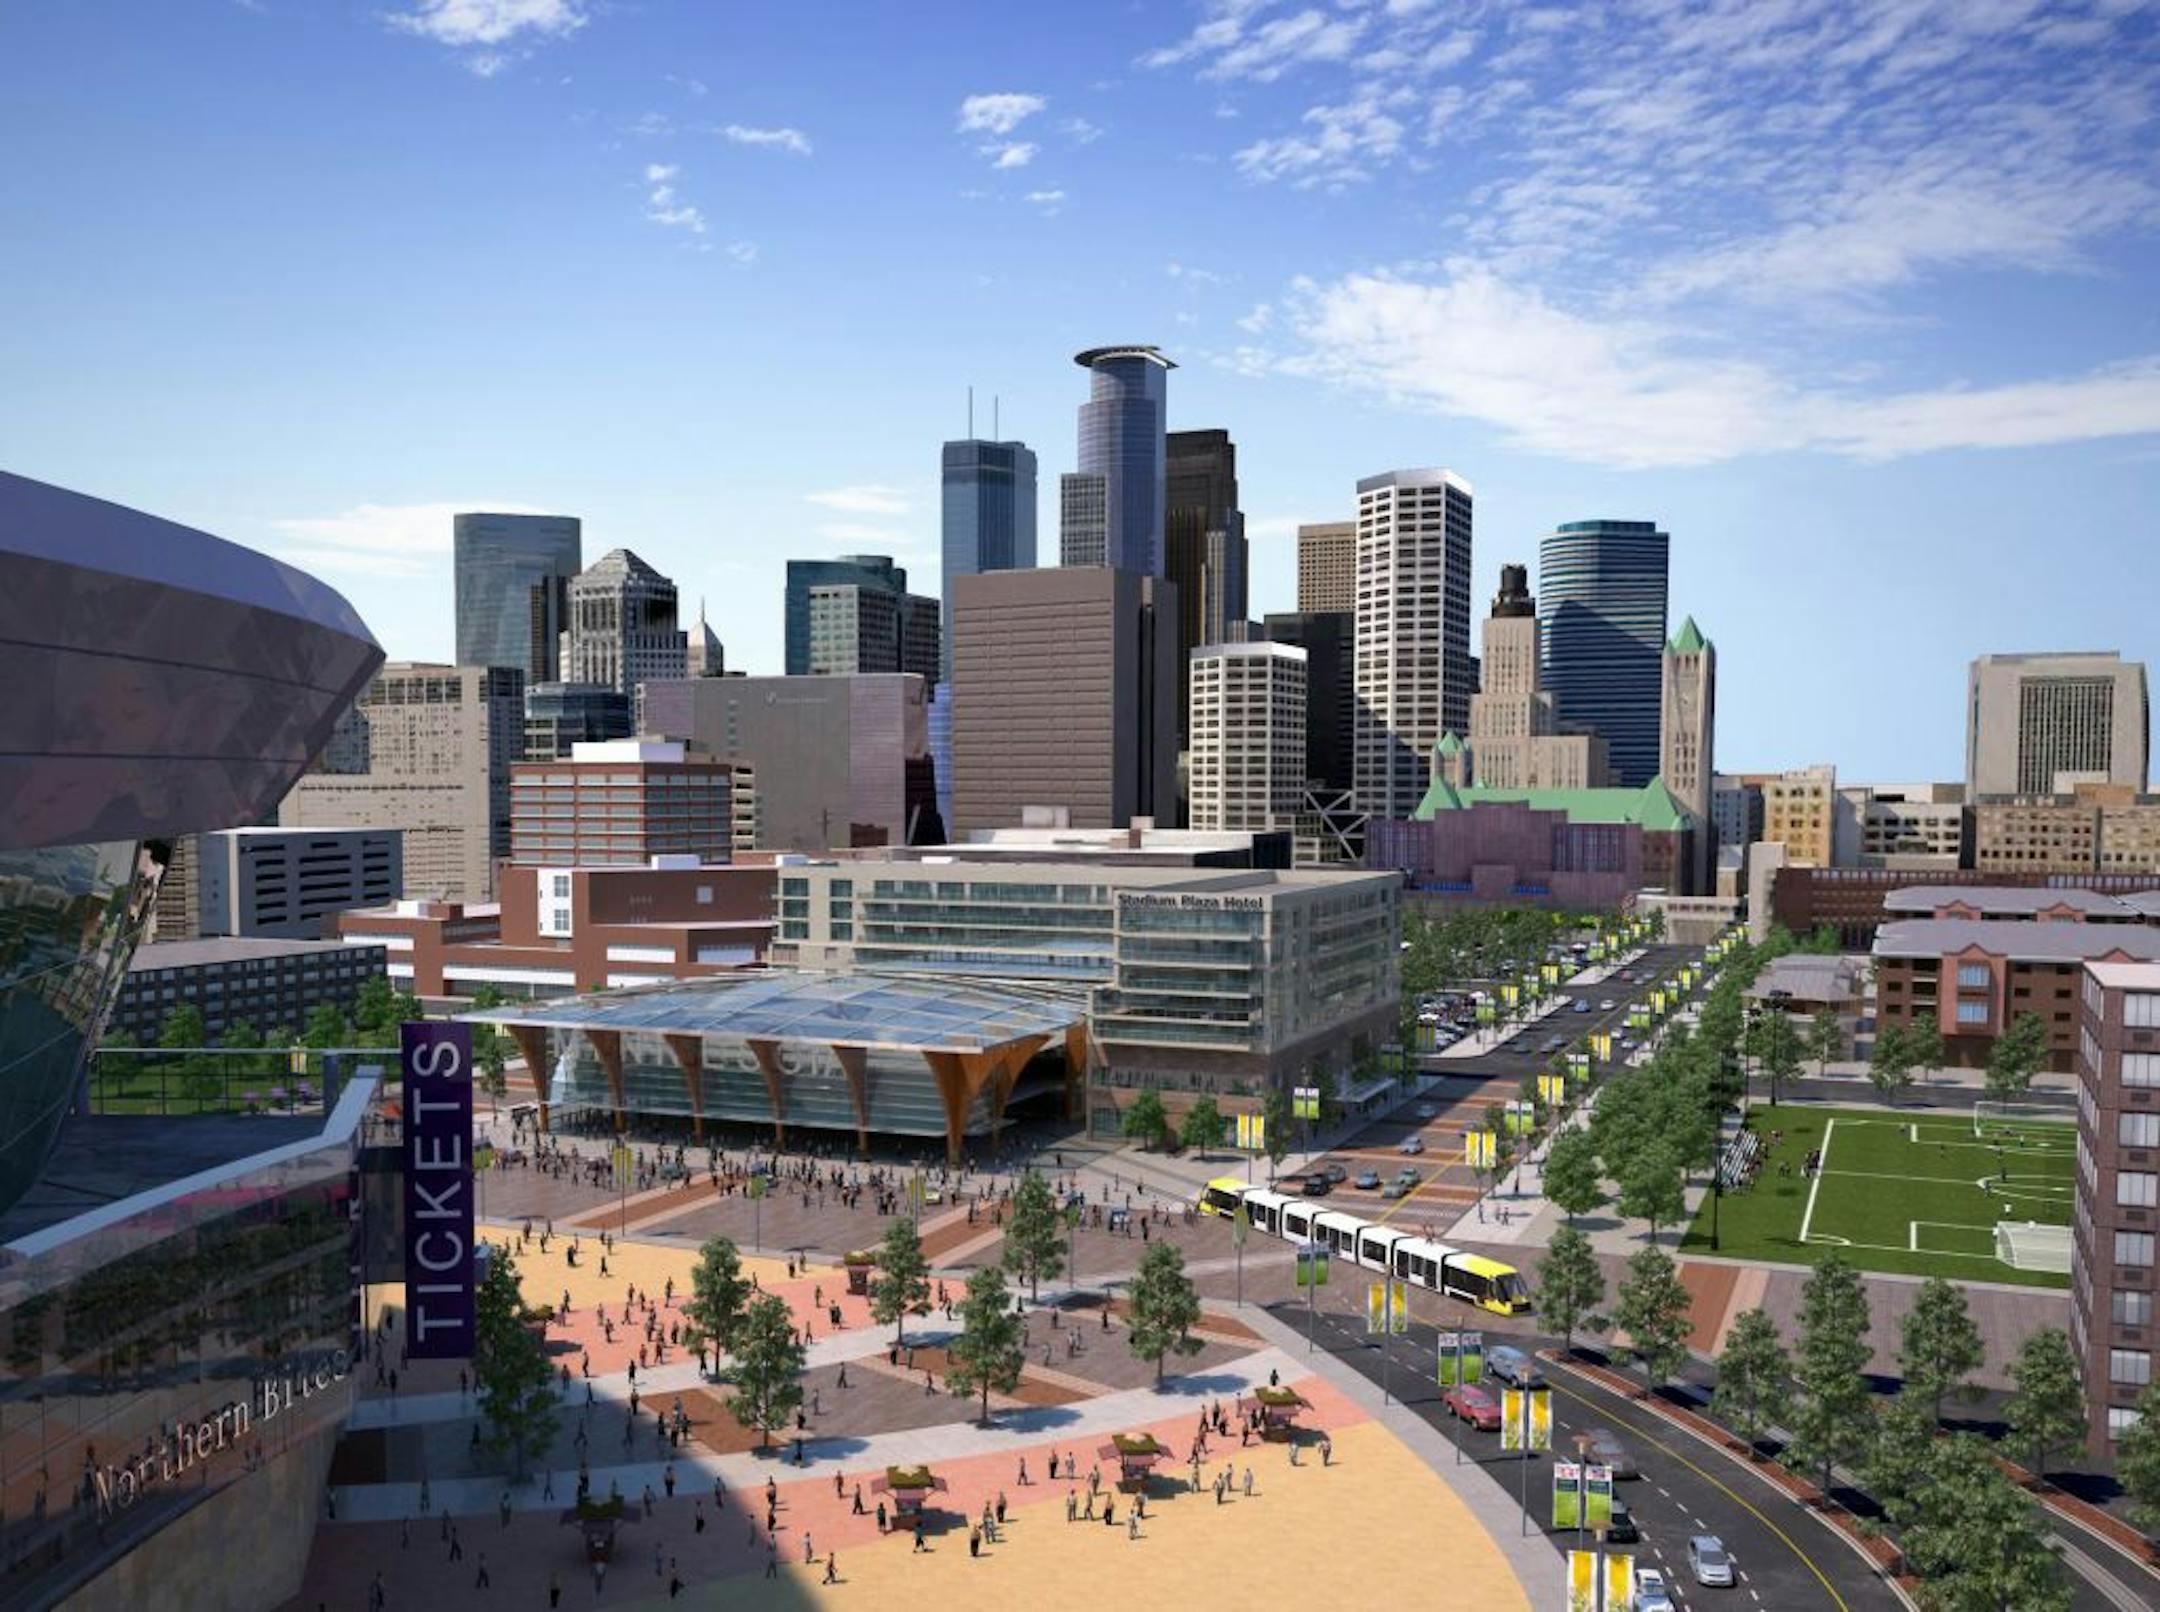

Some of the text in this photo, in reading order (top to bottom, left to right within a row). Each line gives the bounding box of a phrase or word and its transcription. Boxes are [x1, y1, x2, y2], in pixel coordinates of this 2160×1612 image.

[1118, 893, 1263, 908] Stadium Plaza Hotel
[412, 1041, 464, 1343] TICKETS
[96, 1349, 347, 1518] Northern Bites
